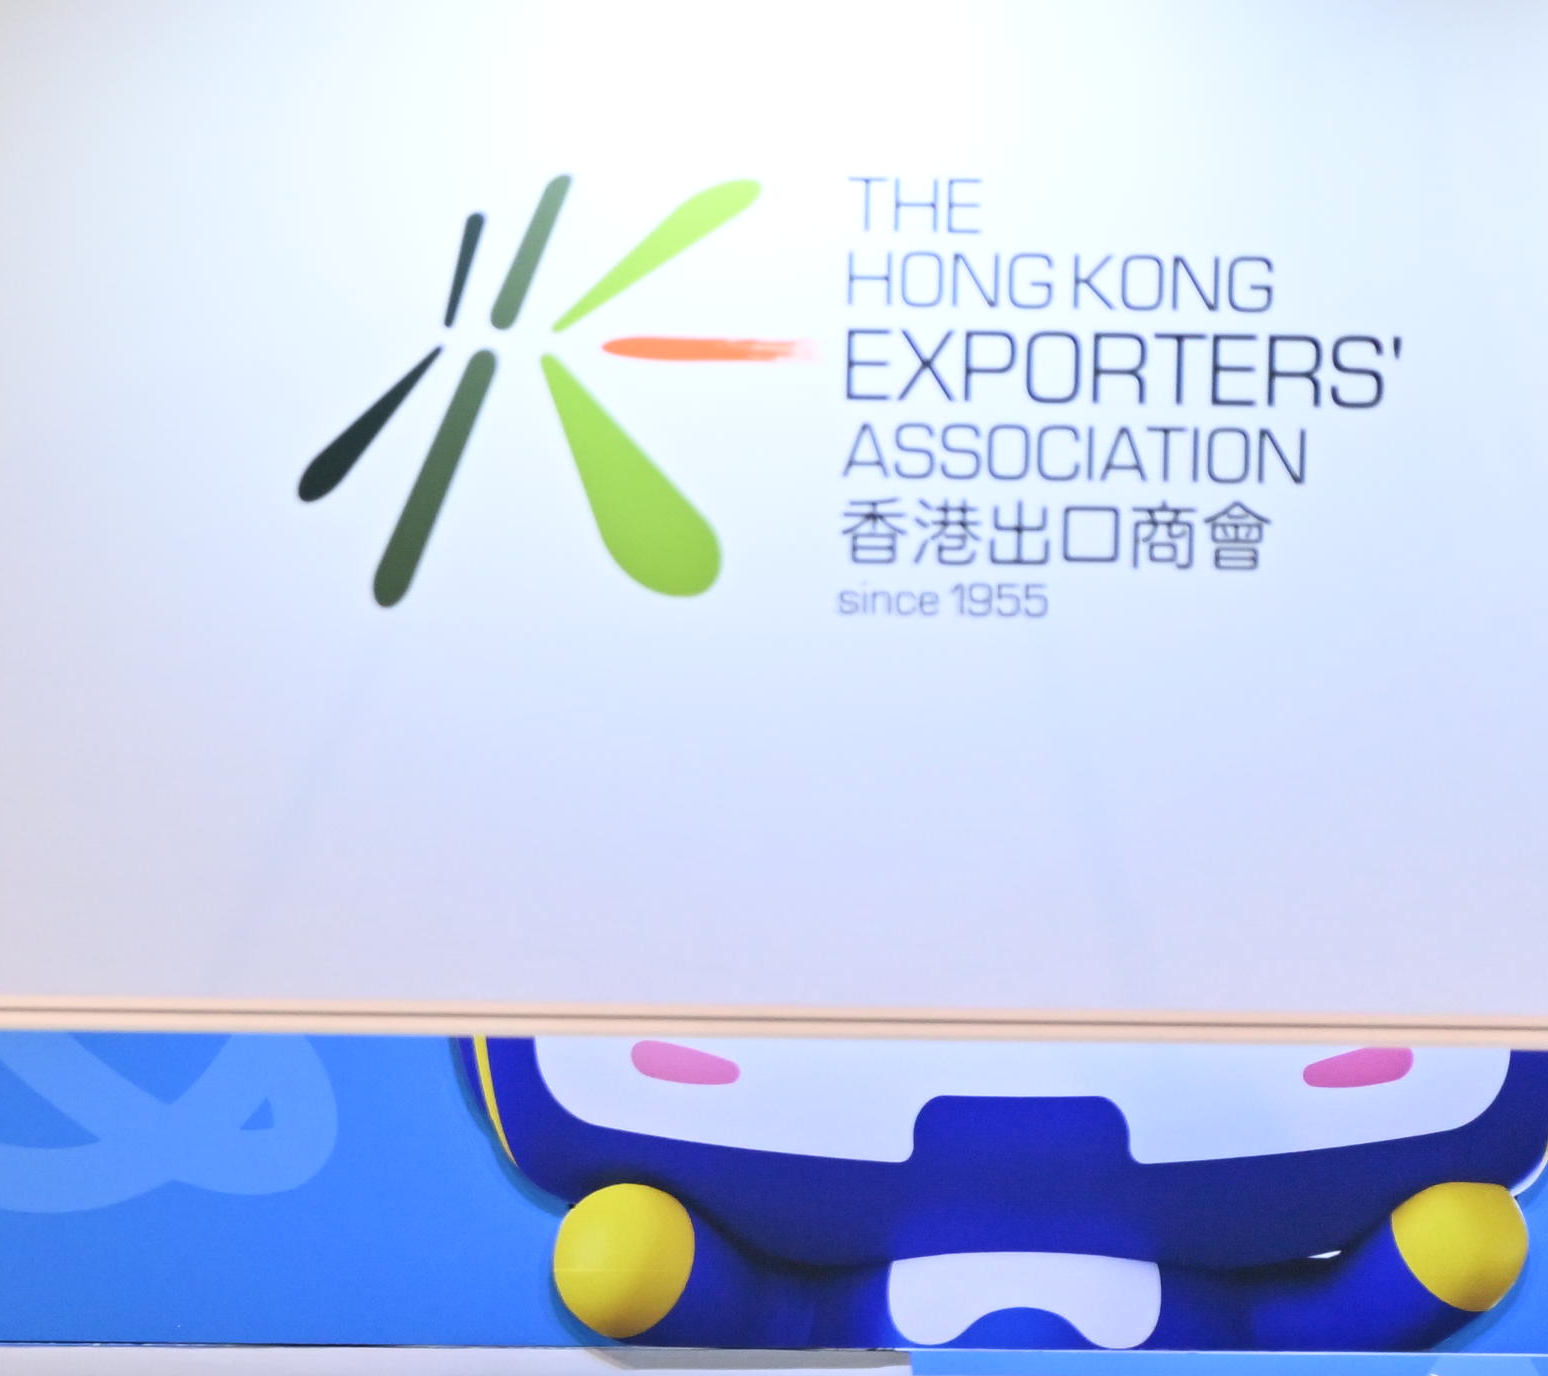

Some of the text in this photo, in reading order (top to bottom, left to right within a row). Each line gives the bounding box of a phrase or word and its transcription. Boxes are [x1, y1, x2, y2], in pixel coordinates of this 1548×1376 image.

[847, 175, 984, 236] THE
[844, 251, 1276, 315] HONG KONG
[843, 328, 1405, 411] EXPORTERS'
[840, 422, 1309, 486] ASSOCIATION
[838, 498, 1274, 572] 香港出口商會
[836, 582, 1050, 619] since 1955
